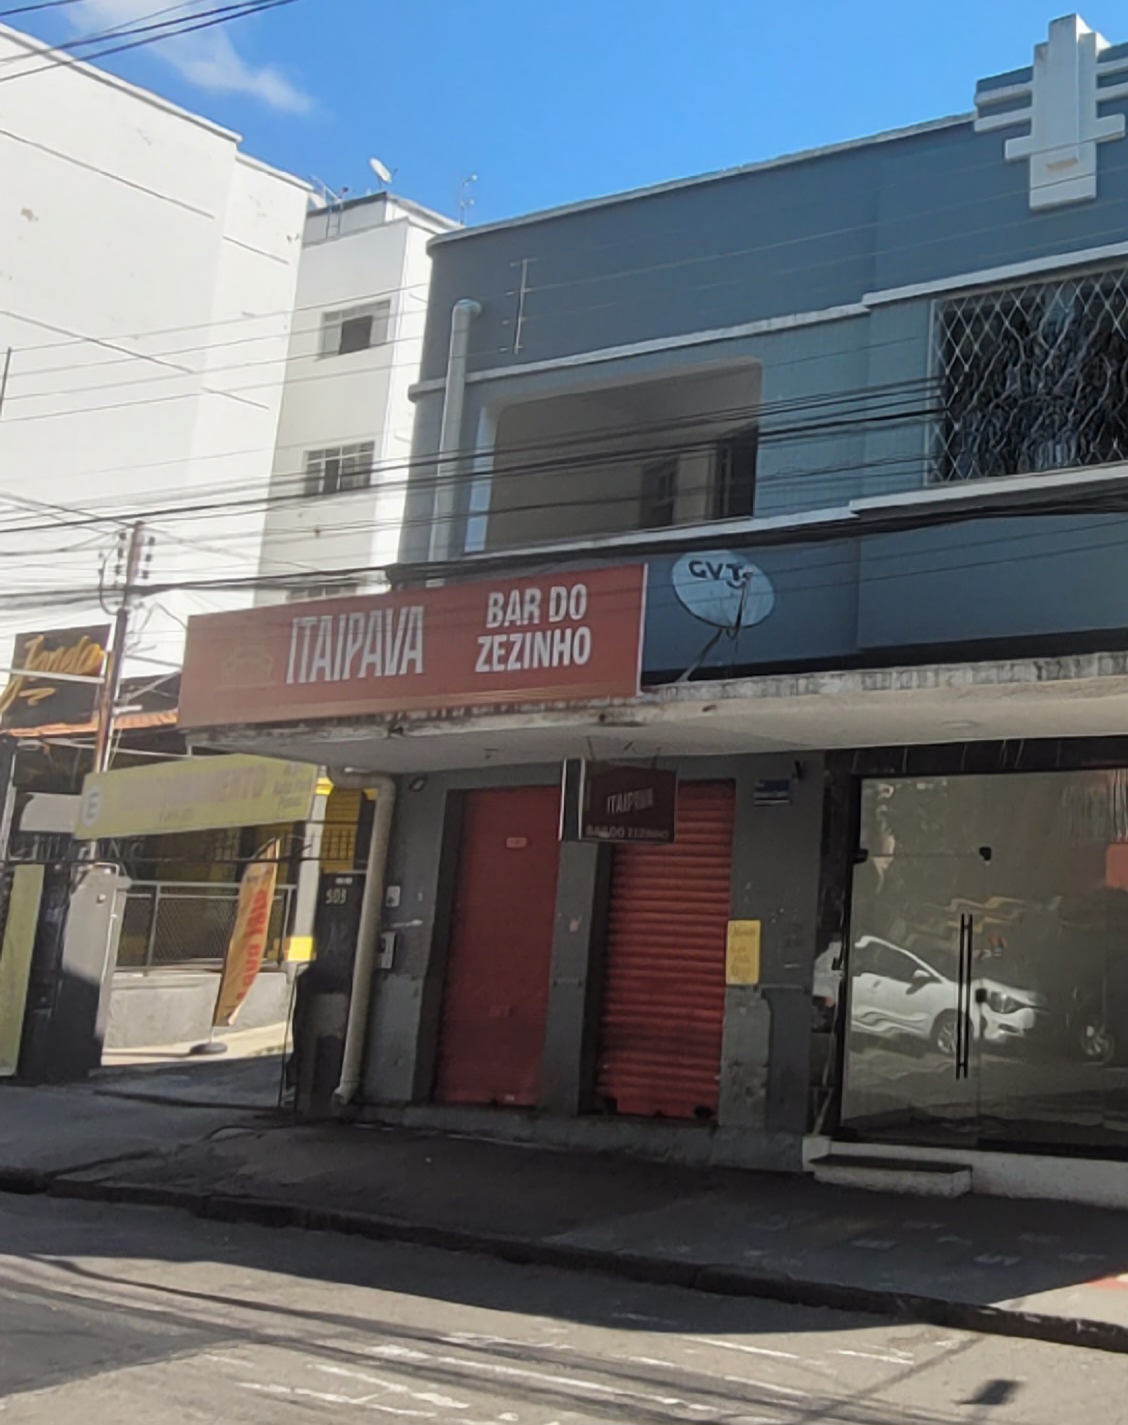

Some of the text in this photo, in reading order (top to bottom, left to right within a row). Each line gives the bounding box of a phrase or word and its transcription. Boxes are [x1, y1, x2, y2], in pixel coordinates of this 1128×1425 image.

[688, 560, 741, 581] GVT
[486, 583, 588, 628] BAR DO
[286, 605, 424, 685] ITAIPAVA
[475, 627, 592, 673] ZEZINHO
